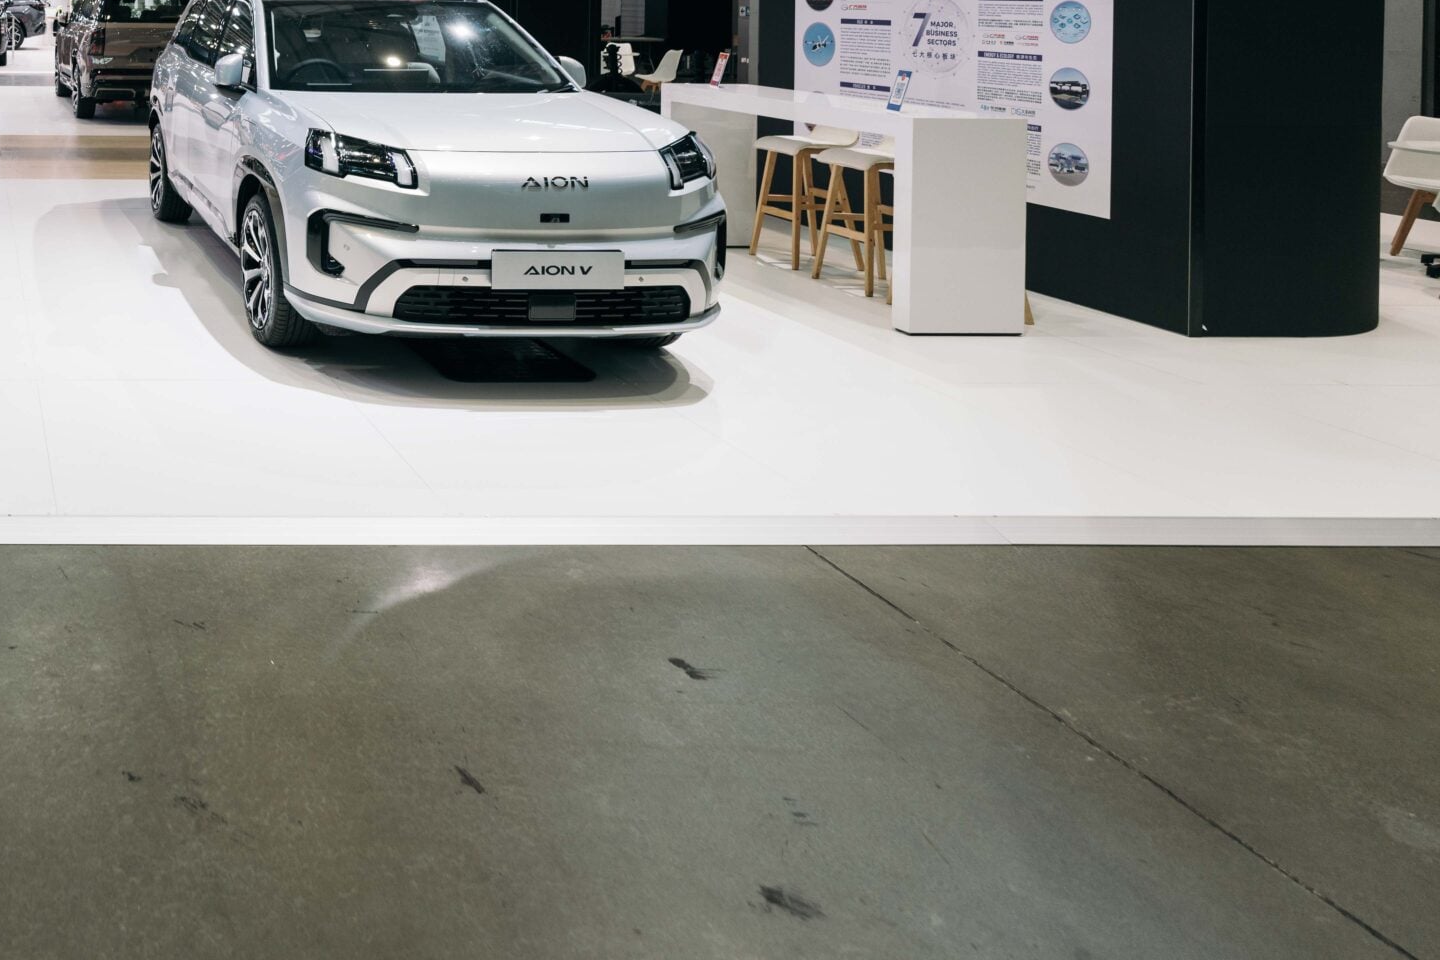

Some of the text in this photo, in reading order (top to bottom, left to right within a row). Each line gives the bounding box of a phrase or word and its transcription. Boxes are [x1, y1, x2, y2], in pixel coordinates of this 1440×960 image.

[912, 13, 931, 46] 7
[521, 176, 588, 190] AION
[524, 266, 593, 276] AION V
